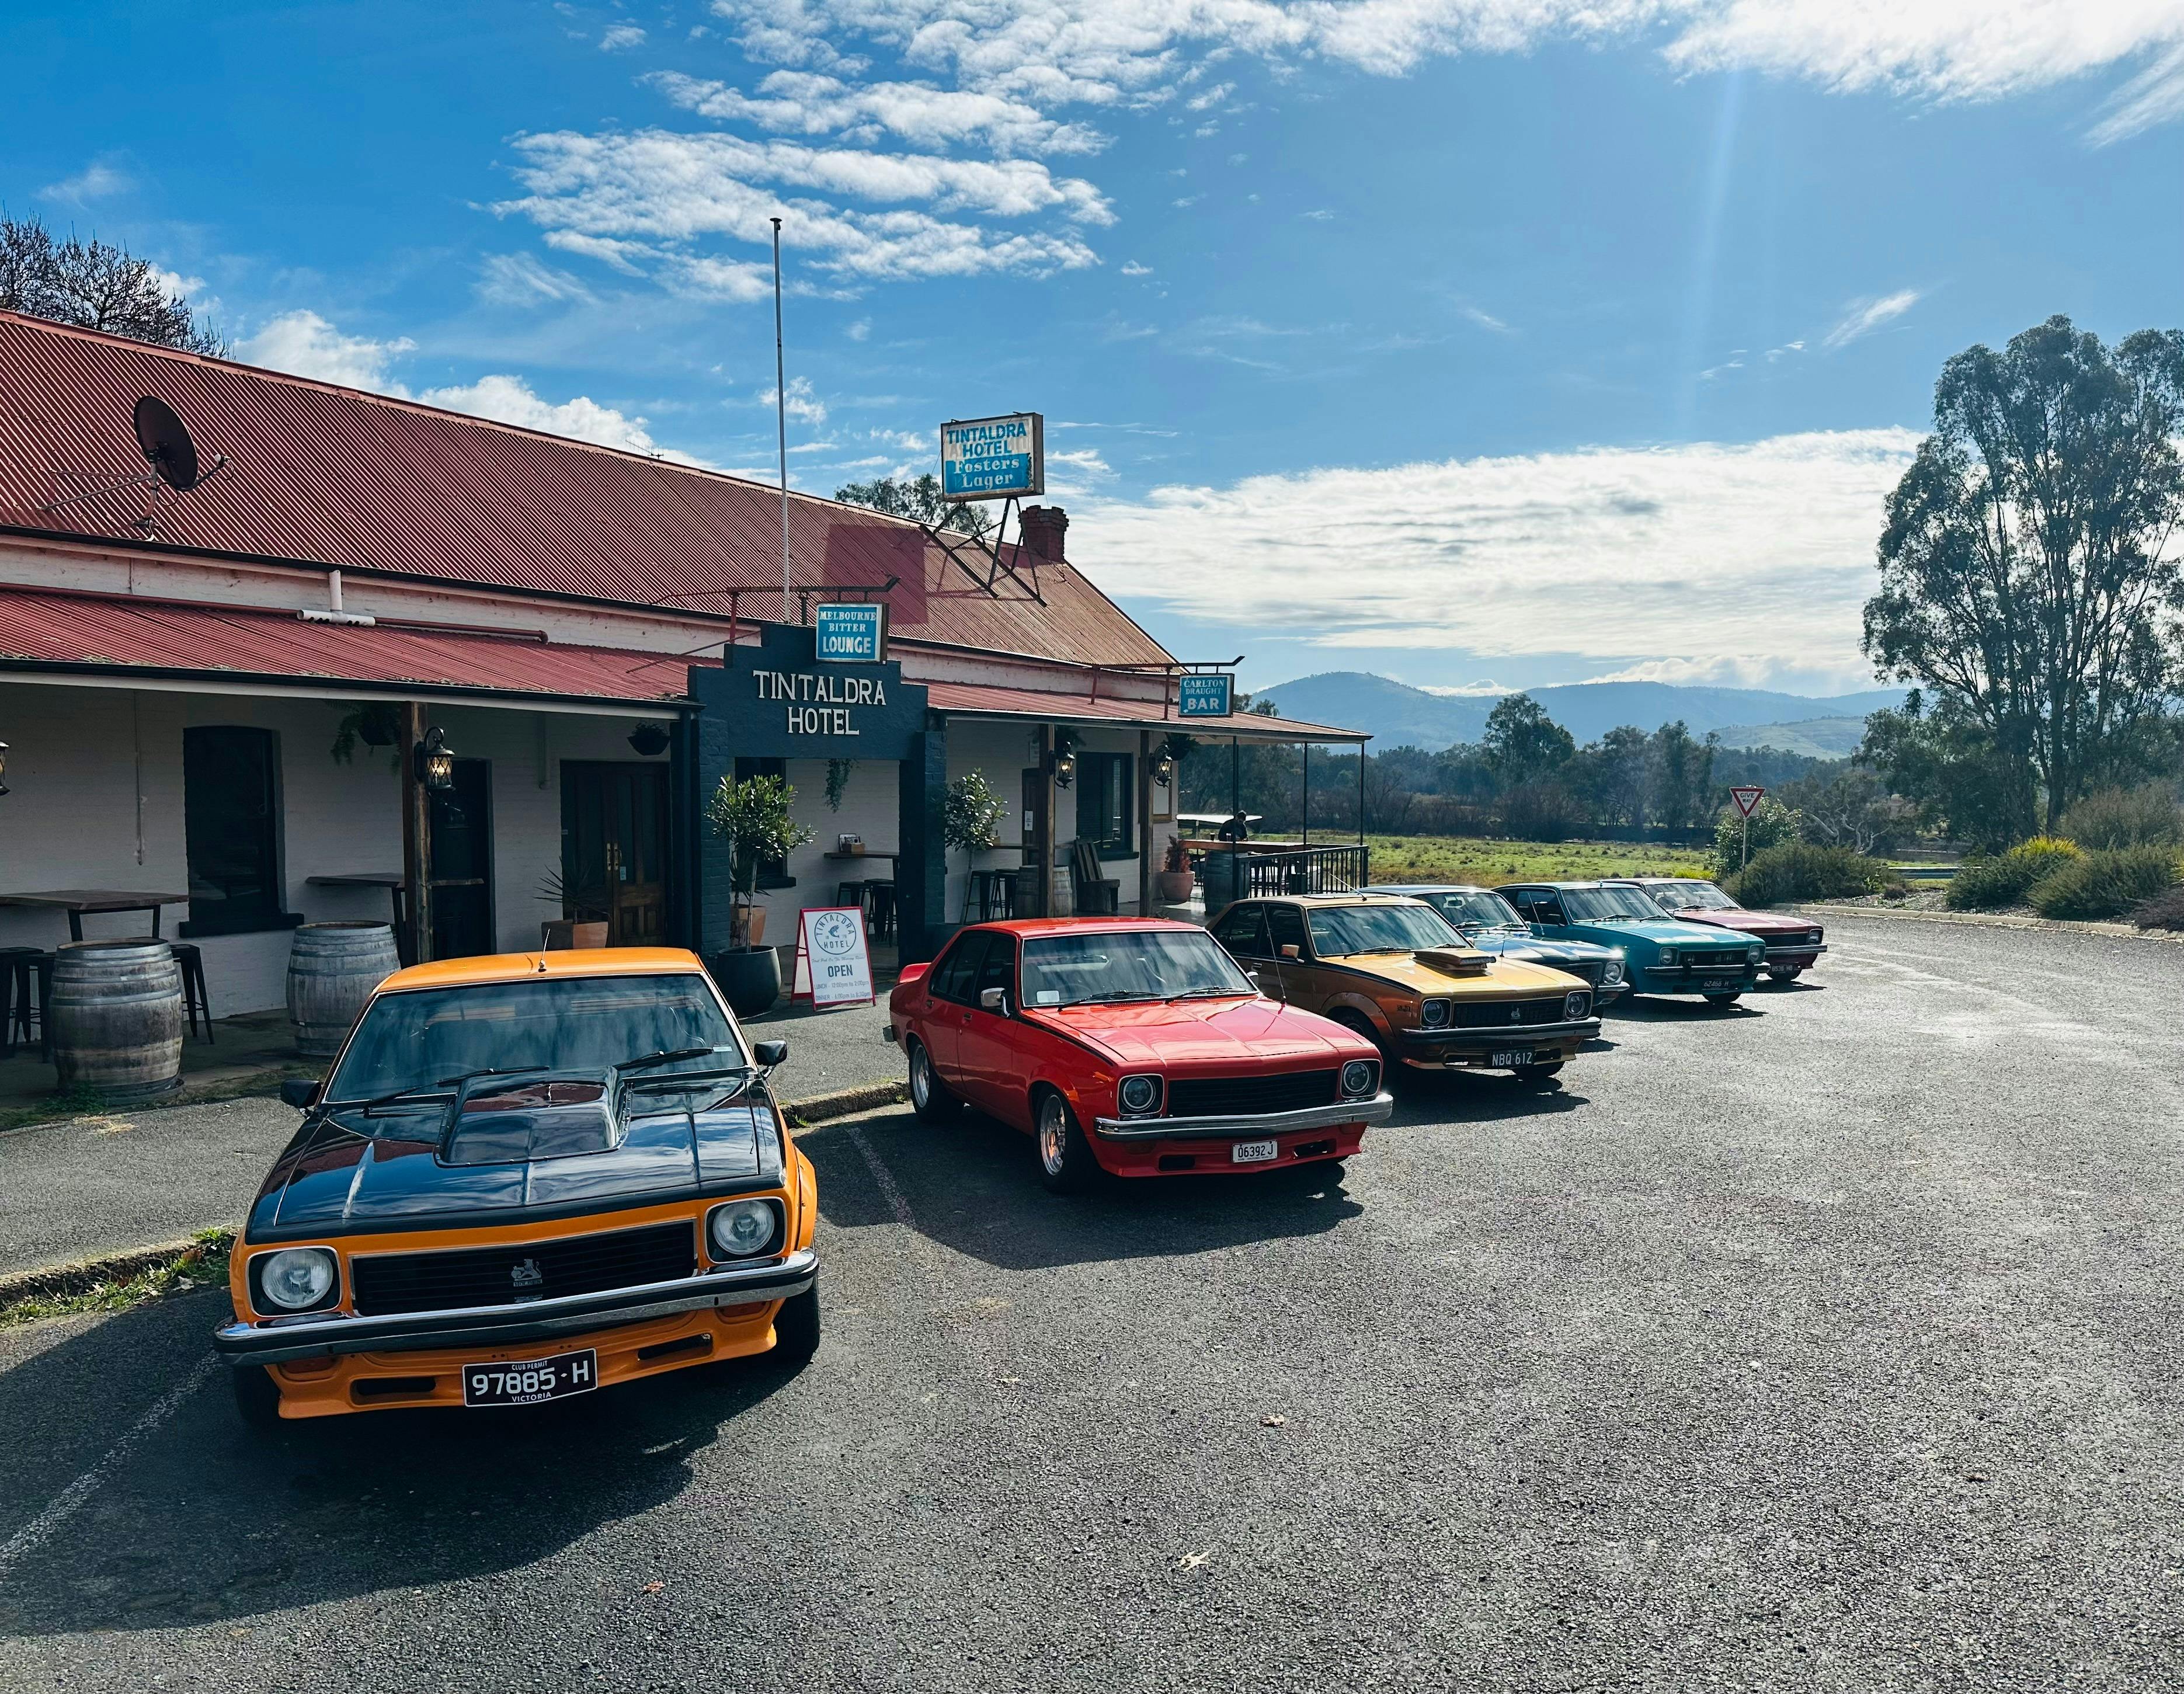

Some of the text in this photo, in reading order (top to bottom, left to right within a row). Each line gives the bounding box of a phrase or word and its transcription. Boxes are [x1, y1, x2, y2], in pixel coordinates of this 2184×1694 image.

[947, 422, 1027, 444] TINTALDRA
[963, 440, 1012, 458] HOTEL
[954, 458, 1020, 474] Fosters
[961, 472, 1014, 489] Lager
[819, 611, 876, 621] MELBOURNE
[828, 623, 866, 632] BITTER
[823, 636, 872, 653] LOUNGE
[753, 670, 886, 705] TINTALDRA
[1184, 679, 1225, 688] CARLTON
[1187, 698, 1219, 710] BAR
[788, 707, 860, 735] HOTEL
[816, 914, 855, 936] TINTALDRA
[824, 940, 850, 949] HOTEL
[827, 965, 853, 978] OPEN
[1492, 1052, 1532, 1066] NBQ 612
[1238, 1143, 1273, 1157] 06392 J
[527, 1360, 548, 1369] PERMIT
[512, 1392, 552, 1402] VICTORIA
